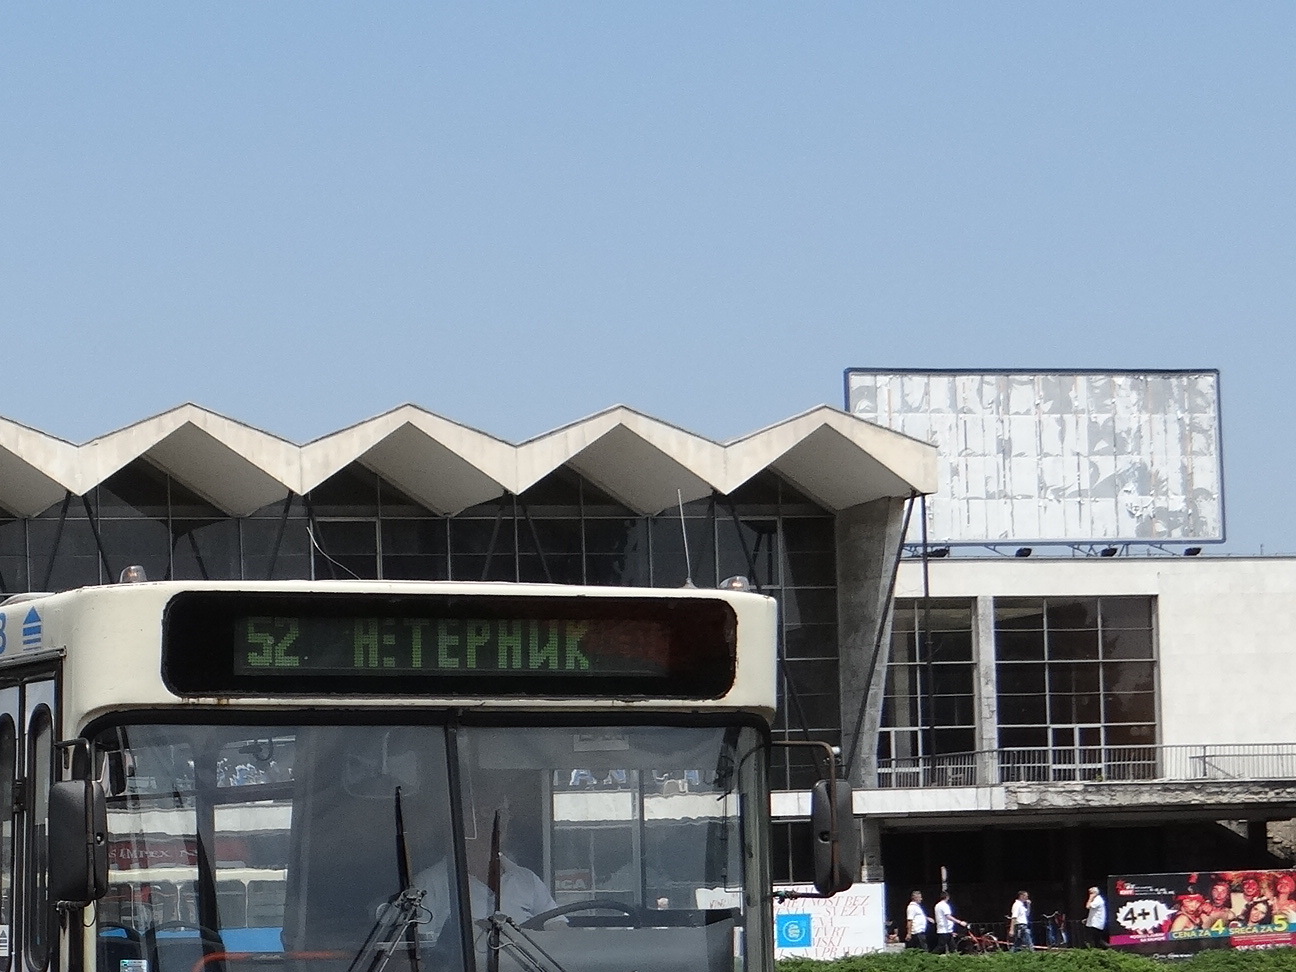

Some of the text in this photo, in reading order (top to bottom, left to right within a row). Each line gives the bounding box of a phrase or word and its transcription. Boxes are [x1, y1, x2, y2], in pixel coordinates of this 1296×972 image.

[247, 617, 299, 667] 52
[1123, 905, 1159, 925] 4+1
[1172, 931, 1196, 939] CENA
[1211, 919, 1225, 934] 4
[1274, 915, 1288, 931] 5
